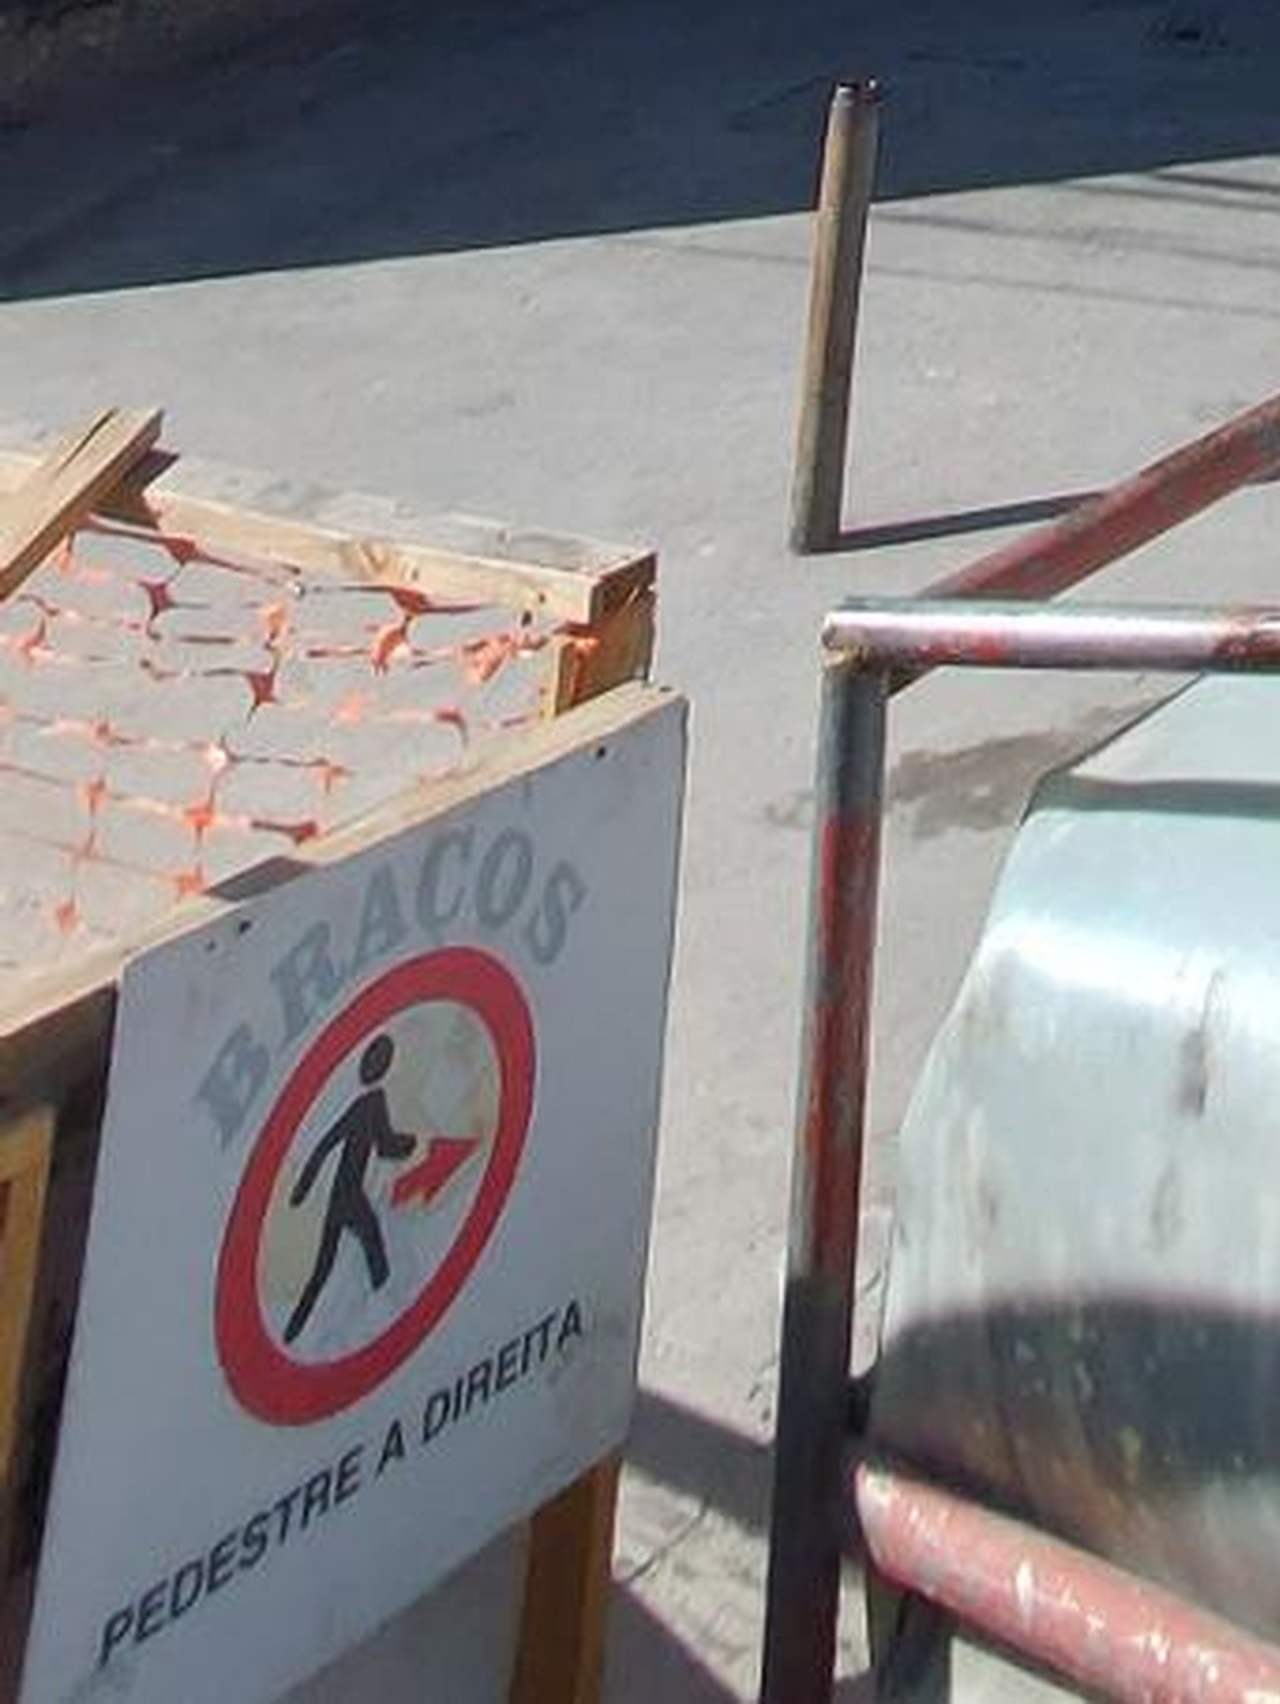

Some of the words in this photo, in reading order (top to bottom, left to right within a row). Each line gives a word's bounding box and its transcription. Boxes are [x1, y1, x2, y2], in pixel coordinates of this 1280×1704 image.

[99, 1427, 364, 1669] PEDESTRE
[375, 1425, 406, 1474] A
[422, 1299, 583, 1444] DIREITA
